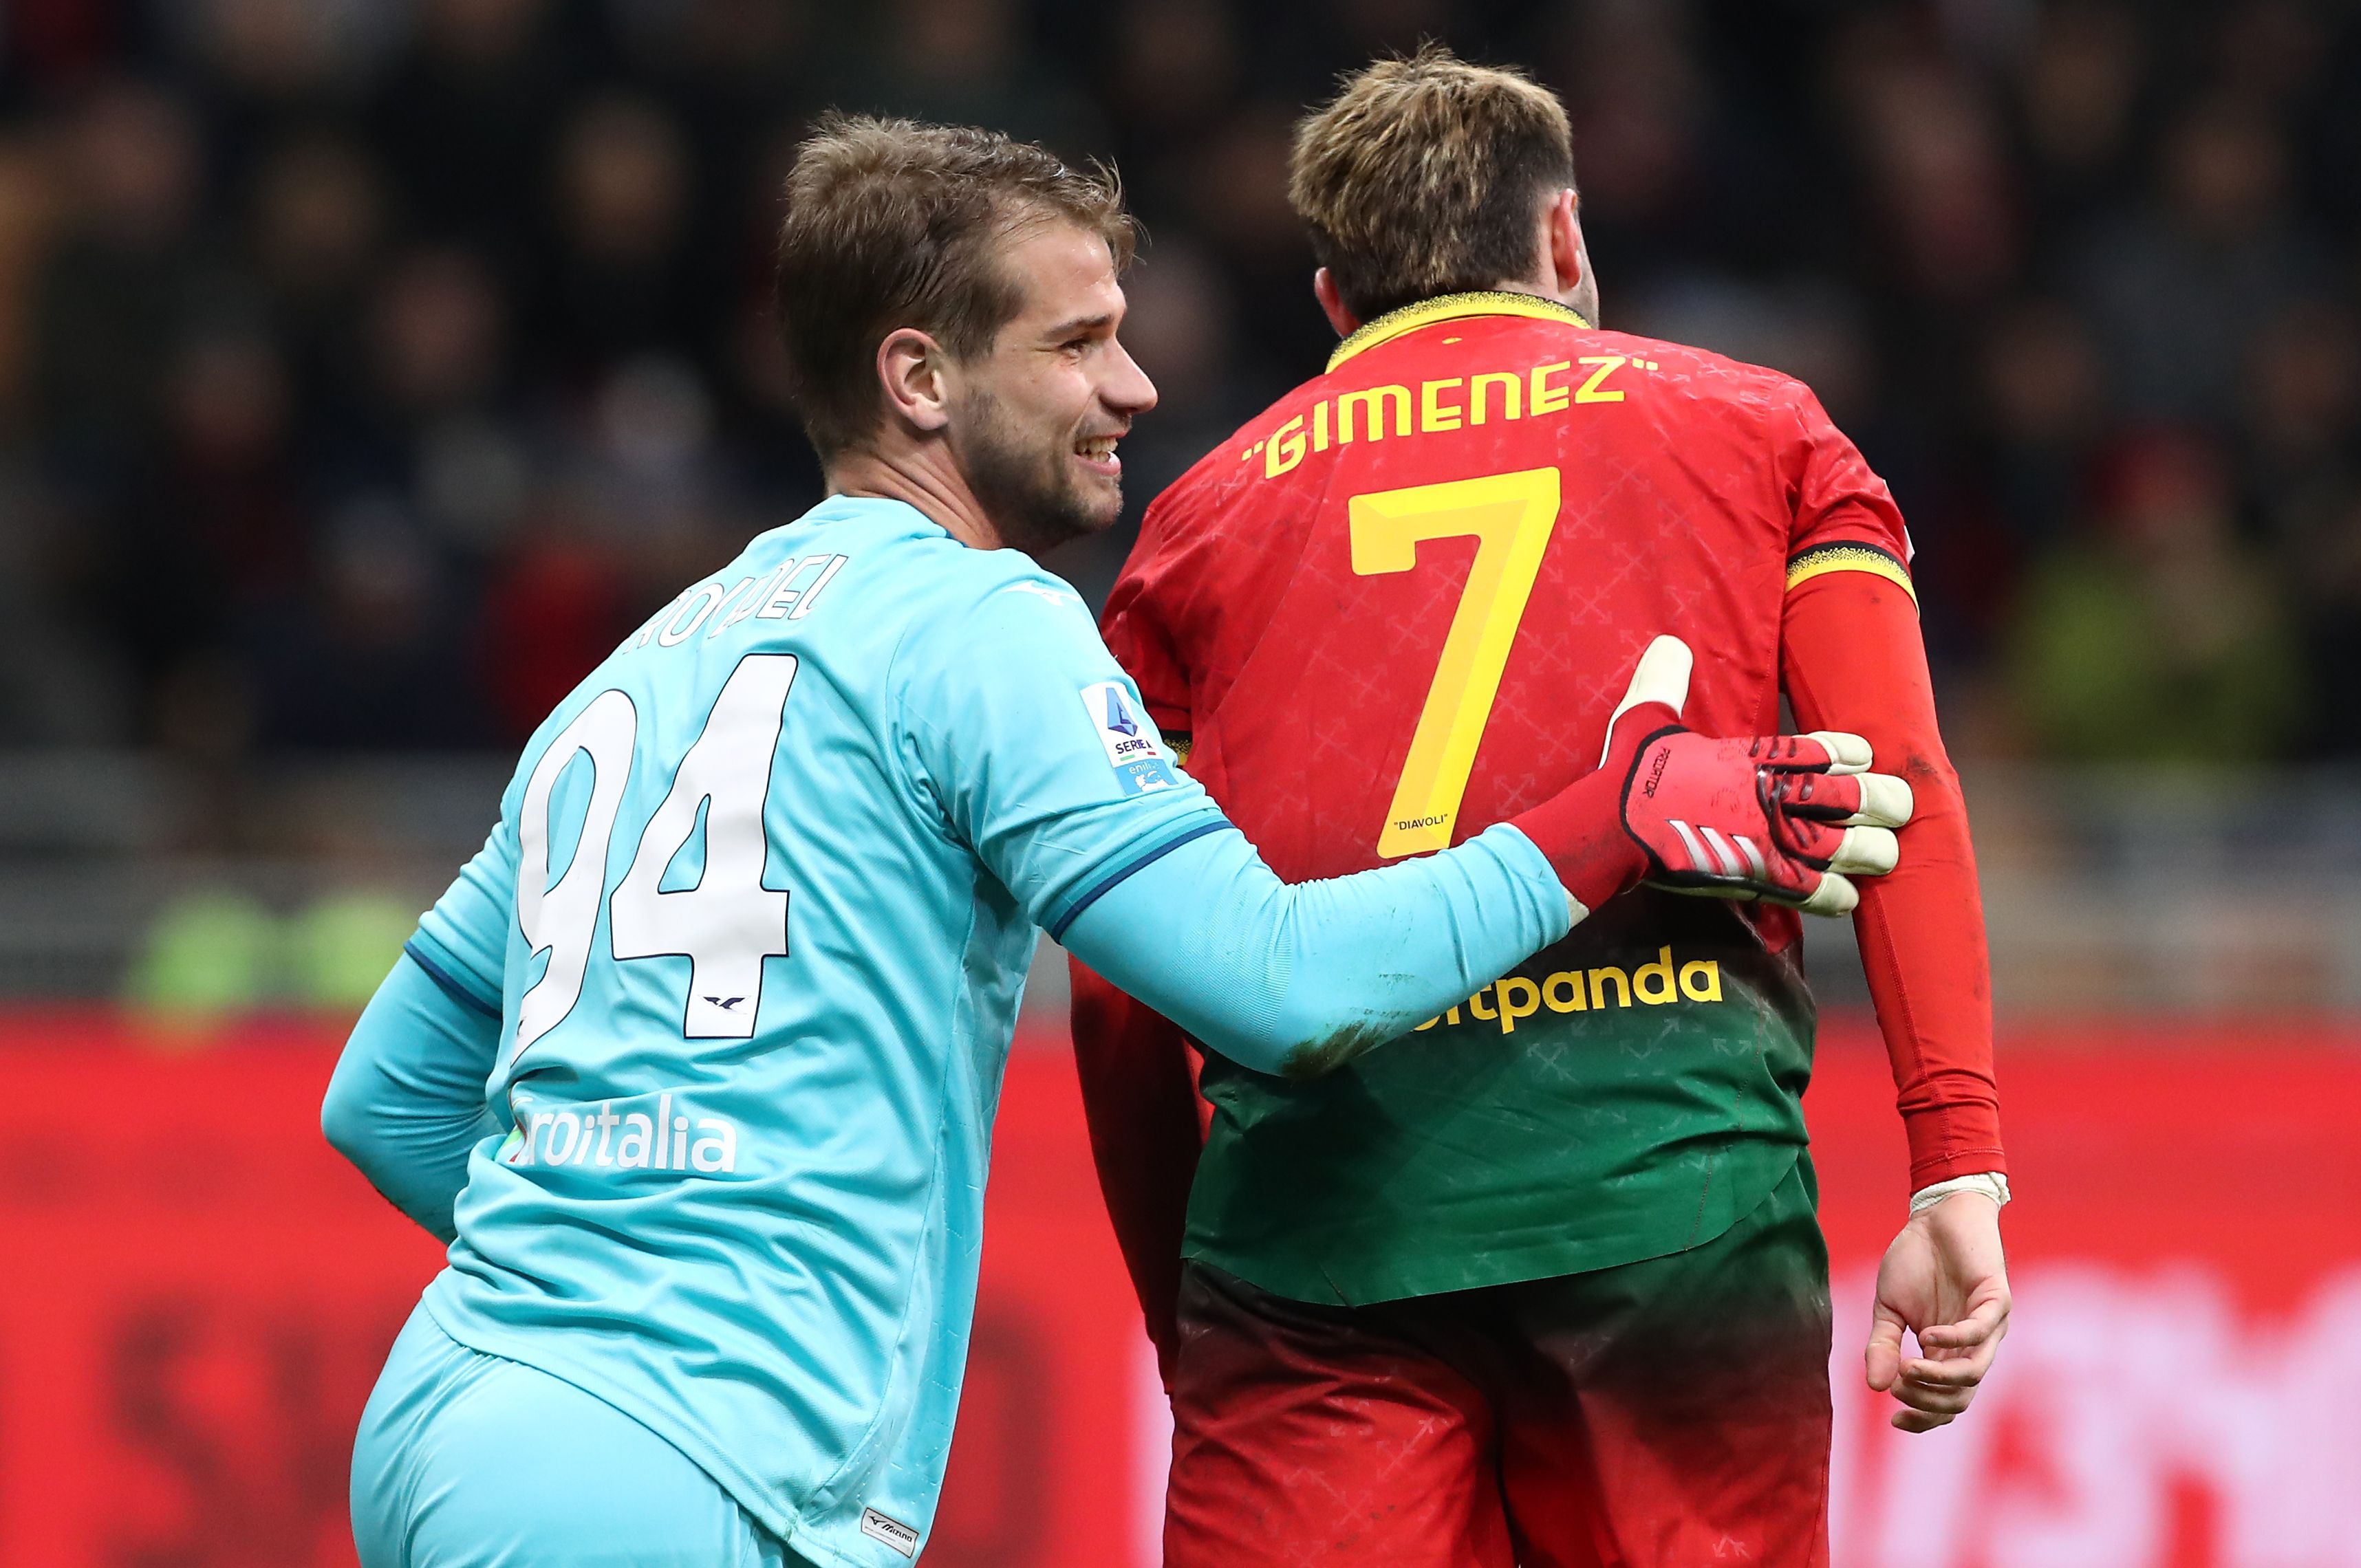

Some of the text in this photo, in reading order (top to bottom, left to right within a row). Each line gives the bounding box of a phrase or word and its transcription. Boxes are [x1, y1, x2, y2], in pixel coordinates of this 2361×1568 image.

[1241, 356, 1658, 479] "GIMENEZ"
[1347, 466, 1561, 860] 7
[1115, 739, 1147, 754] SERIE
[1642, 747, 1670, 798] PREDATOR
[511, 653, 799, 1067] 94
[1394, 814, 1447, 830] "DIAVOLI"
[1411, 944, 1723, 1034] tpanda
[513, 1093, 737, 1173] roitalia
